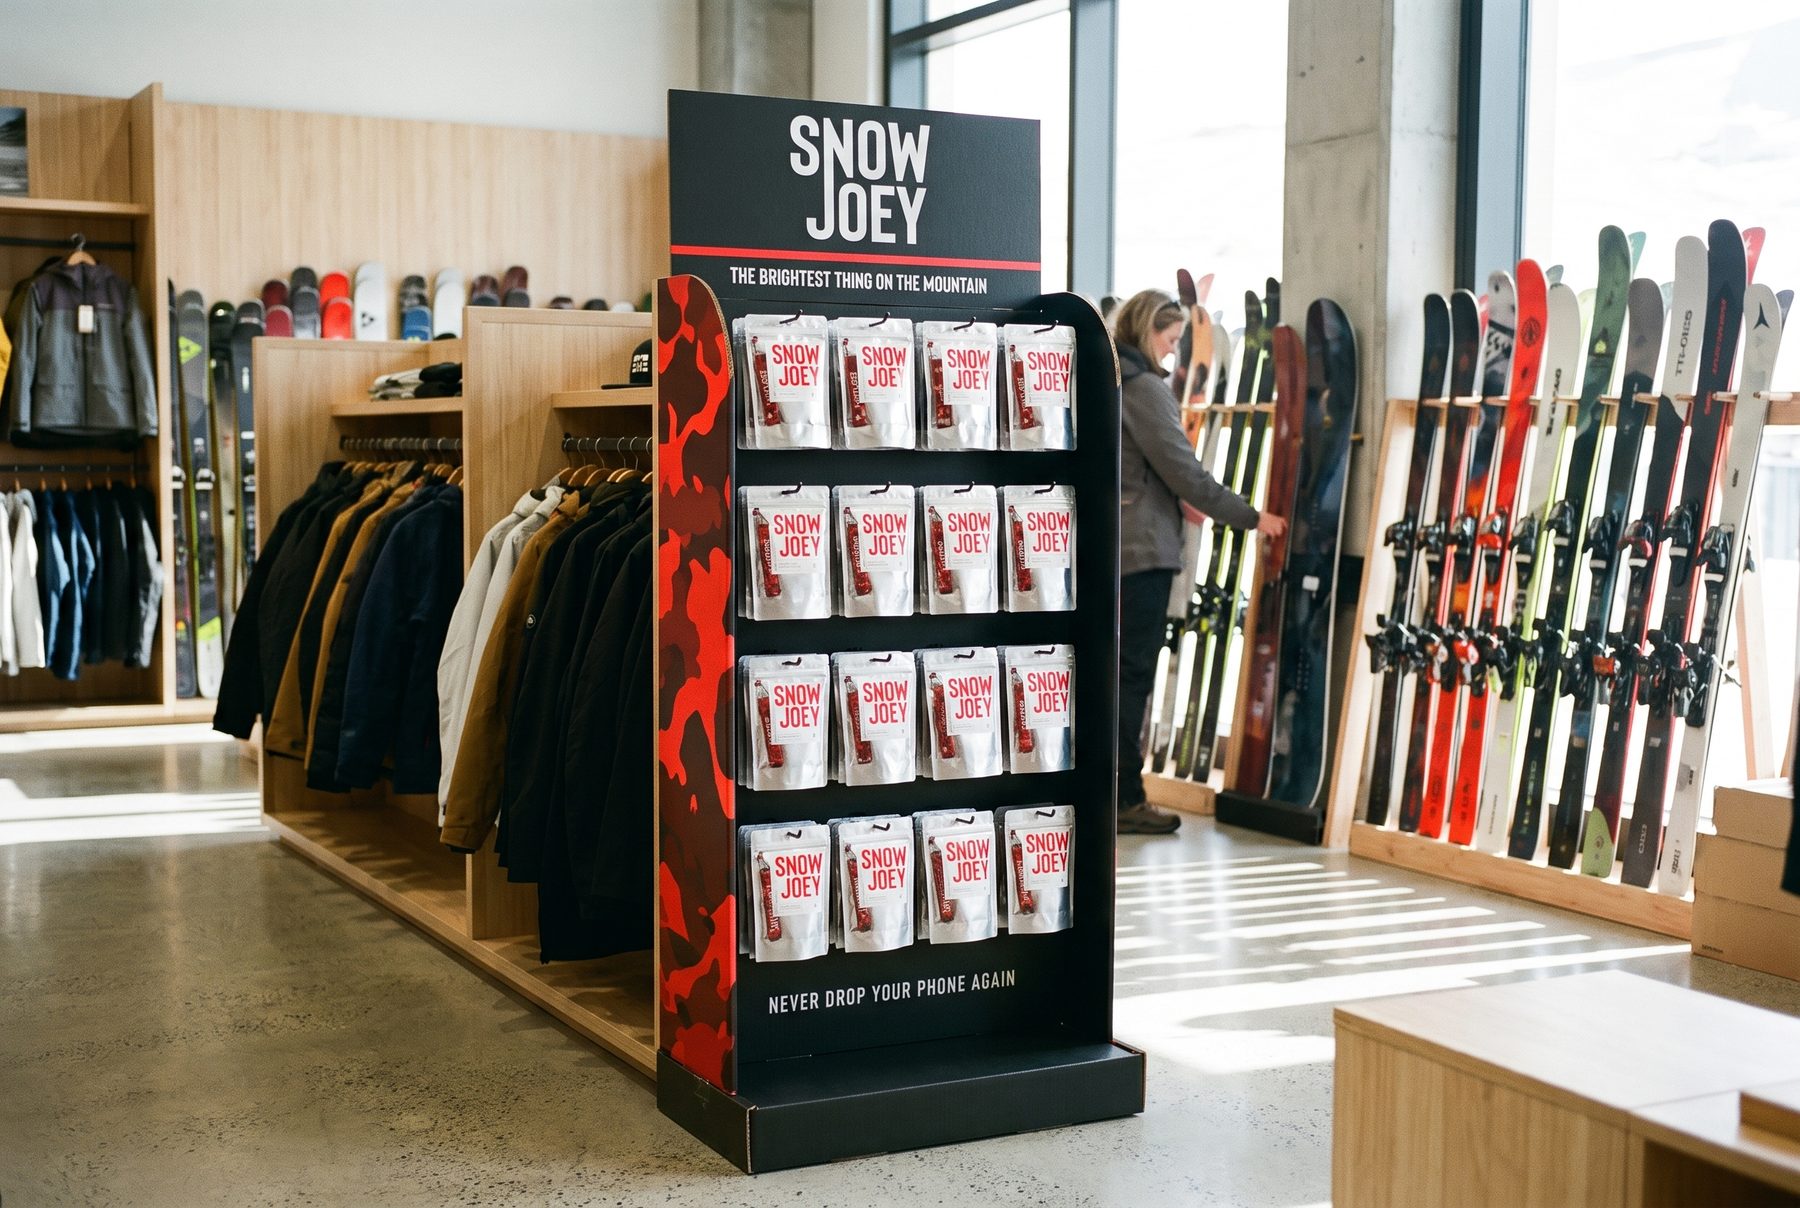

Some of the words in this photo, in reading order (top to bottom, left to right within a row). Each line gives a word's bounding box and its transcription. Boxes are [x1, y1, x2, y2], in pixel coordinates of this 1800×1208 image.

[789, 115, 930, 183] SNOW
[806, 183, 927, 245] JOEY
[730, 267, 756, 285] THE
[760, 268, 831, 288] BRIGHTEST
[835, 272, 872, 290] THING
[876, 273, 893, 290] ON
[896, 274, 920, 291] THE
[923, 275, 987, 294] MOUNTAIN
[772, 344, 819, 365] SNOW
[862, 346, 906, 366] SNOW
[947, 349, 990, 369] SNOW
[1027, 352, 1070, 371] SNOW
[779, 366, 819, 386] JOEY
[868, 367, 904, 387] JOEY
[953, 370, 989, 390] JOEY
[1034, 372, 1069, 392] JOEY
[774, 514, 820, 534] SNOW
[862, 514, 907, 534] SNOW
[948, 512, 990, 532] SNOW
[1028, 512, 1069, 531] SNOW
[779, 535, 820, 557] JOEY
[869, 535, 906, 555] JOEY
[953, 533, 990, 553] JOEY
[1033, 532, 1069, 552] JOEY
[863, 681, 908, 702] SNOW
[948, 676, 992, 697] SNOW
[1027, 671, 1069, 692] SNOW
[774, 684, 820, 706] SNOW
[1033, 691, 1069, 713] JOEY
[780, 707, 819, 728] JOEY
[869, 703, 907, 724] JOEY
[955, 697, 992, 719] JOEY
[946, 839, 989, 861] SNOW
[1026, 831, 1069, 853] SNOW
[775, 853, 822, 876] SNOW
[861, 846, 906, 869] SNOW
[1032, 852, 1068, 874] JOEY
[868, 868, 905, 891] JOEY
[953, 860, 988, 882] JOEY
[781, 875, 820, 899] JOEY
[769, 993, 819, 1014] NEVER
[825, 988, 865, 1007] DROP
[872, 982, 911, 1002] YOUR
[917, 975, 965, 997] PHONE
[971, 969, 1015, 991] AGAIN
